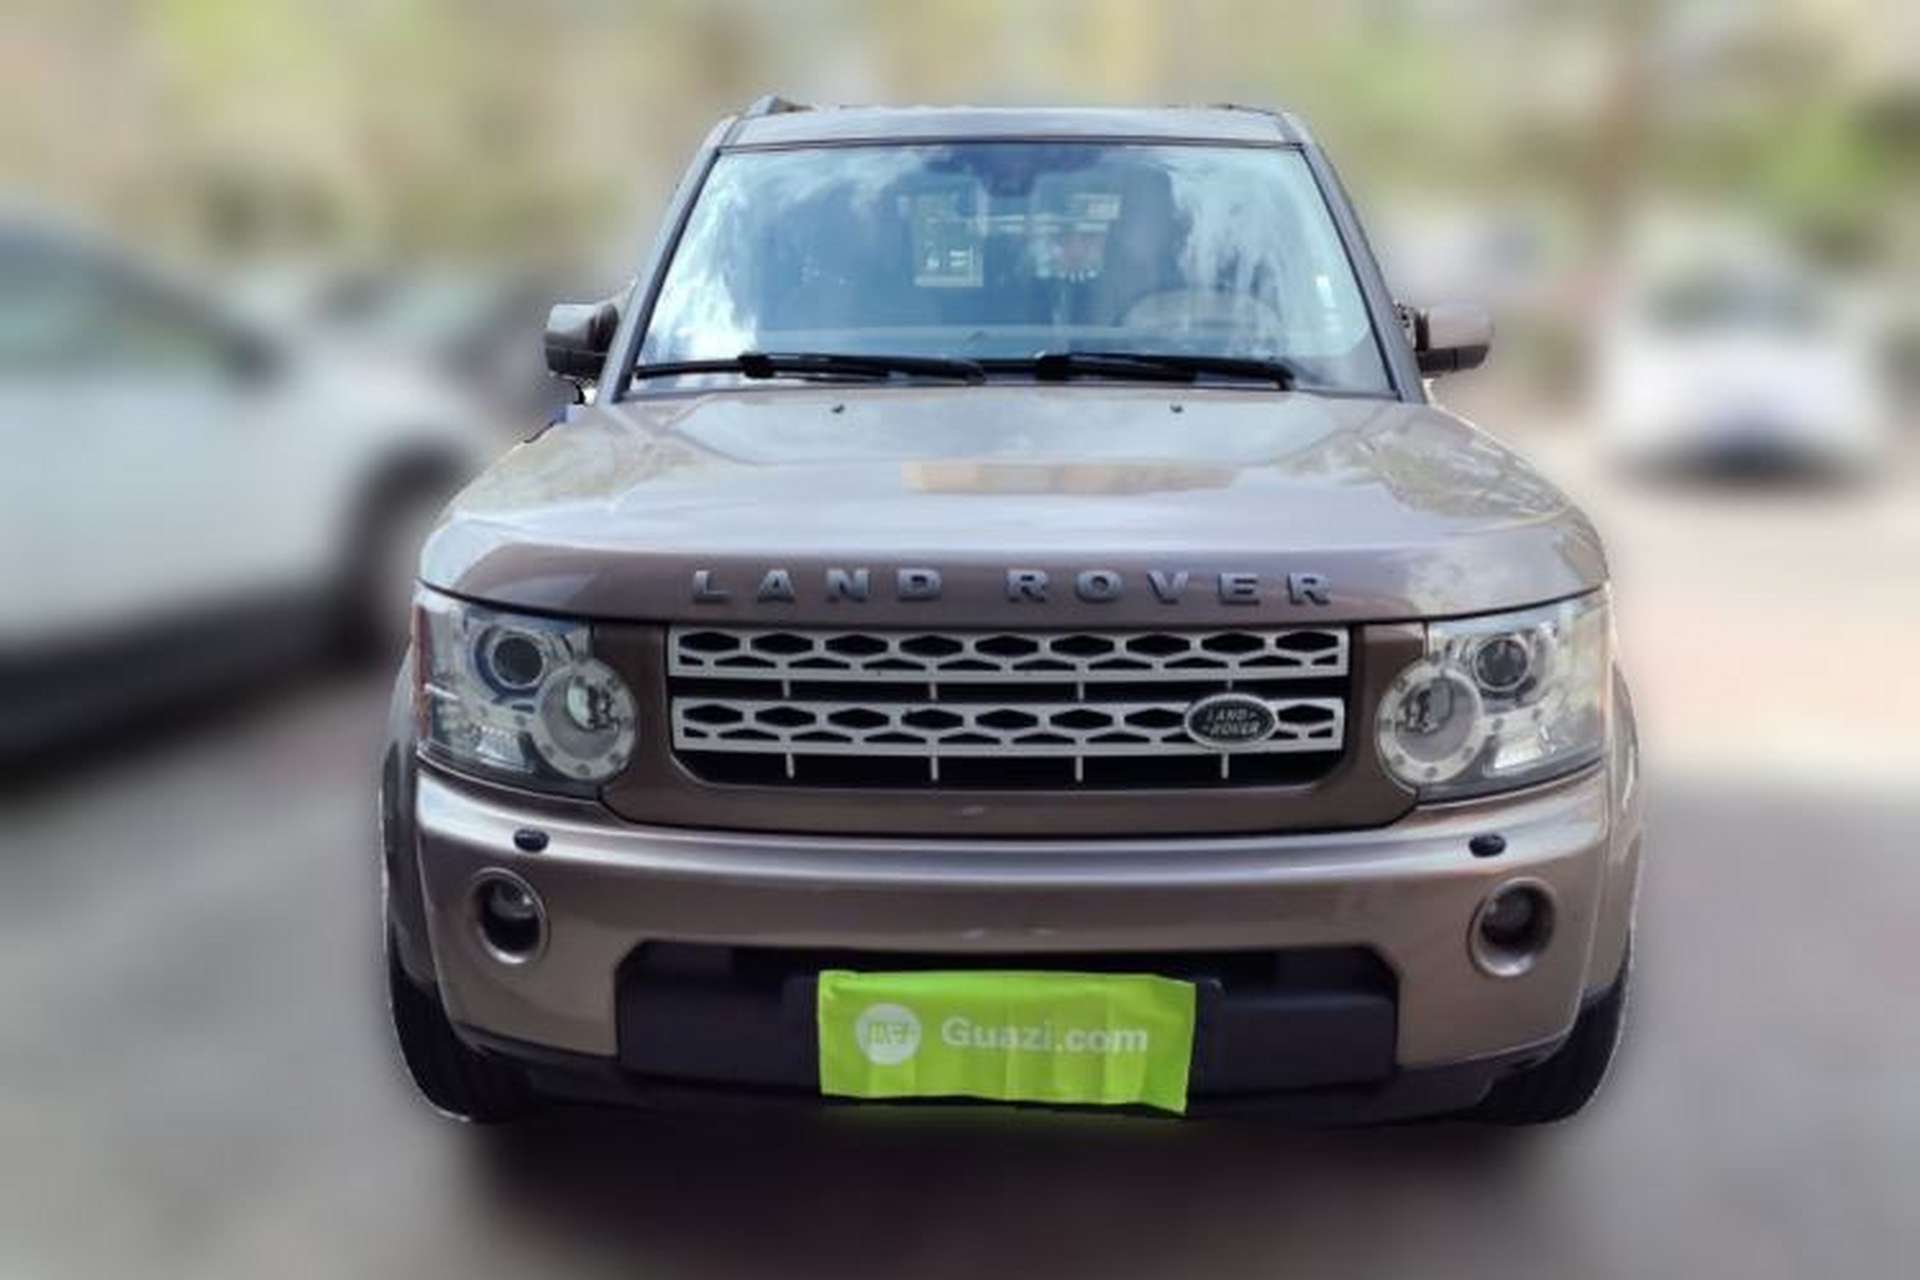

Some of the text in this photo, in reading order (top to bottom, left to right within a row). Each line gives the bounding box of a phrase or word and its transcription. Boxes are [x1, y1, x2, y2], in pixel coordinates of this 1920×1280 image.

[692, 568, 1334, 606] LAND ROVER
[940, 1016, 1149, 1055] Guazi.com
